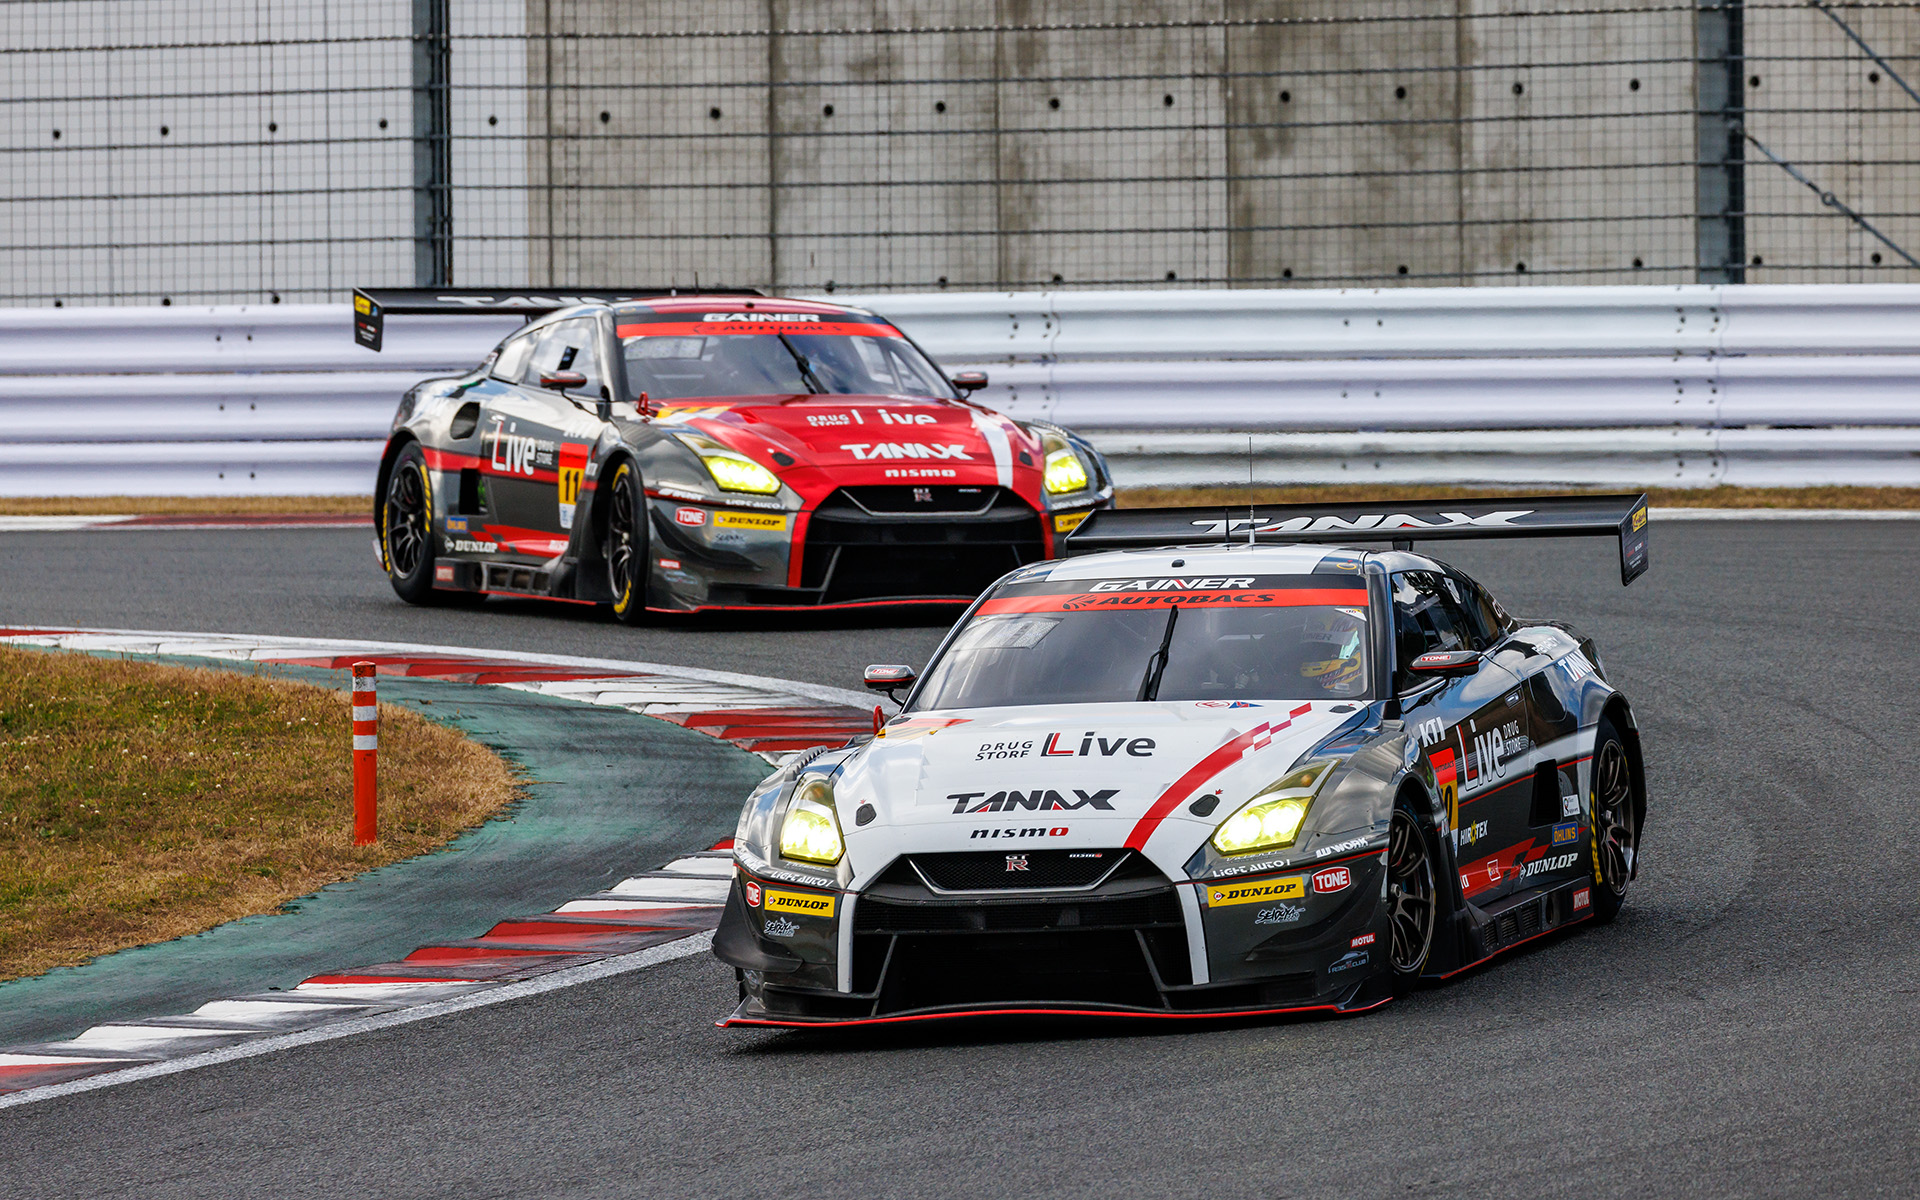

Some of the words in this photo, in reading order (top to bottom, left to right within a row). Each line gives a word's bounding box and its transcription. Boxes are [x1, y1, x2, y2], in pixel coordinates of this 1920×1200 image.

[703, 313, 820, 322] GAINER
[807, 414, 850, 422] DRUG
[491, 415, 535, 475] Live
[840, 443, 974, 460] TANAX
[565, 470, 579, 501] 11
[679, 510, 703, 524] TONE
[728, 517, 780, 526] DUNLOP
[1192, 510, 1534, 533] TANAX
[455, 540, 498, 553] DUNLOP
[1089, 577, 1257, 592] GAINER
[1096, 593, 1276, 605] AUTOBACS
[1503, 720, 1519, 738] DRUG
[980, 740, 1033, 751] DRUG
[1041, 731, 1156, 757] Live
[1506, 738, 1521, 756] STORE
[1456, 719, 1506, 791] Live
[947, 789, 1121, 814] TANAX
[1526, 853, 1578, 877] DUNLOP
[1316, 870, 1348, 889] TONE
[1227, 884, 1296, 899] DUNLOP
[777, 897, 829, 910] DUNLOP
[1352, 934, 1374, 947] MOTUL
